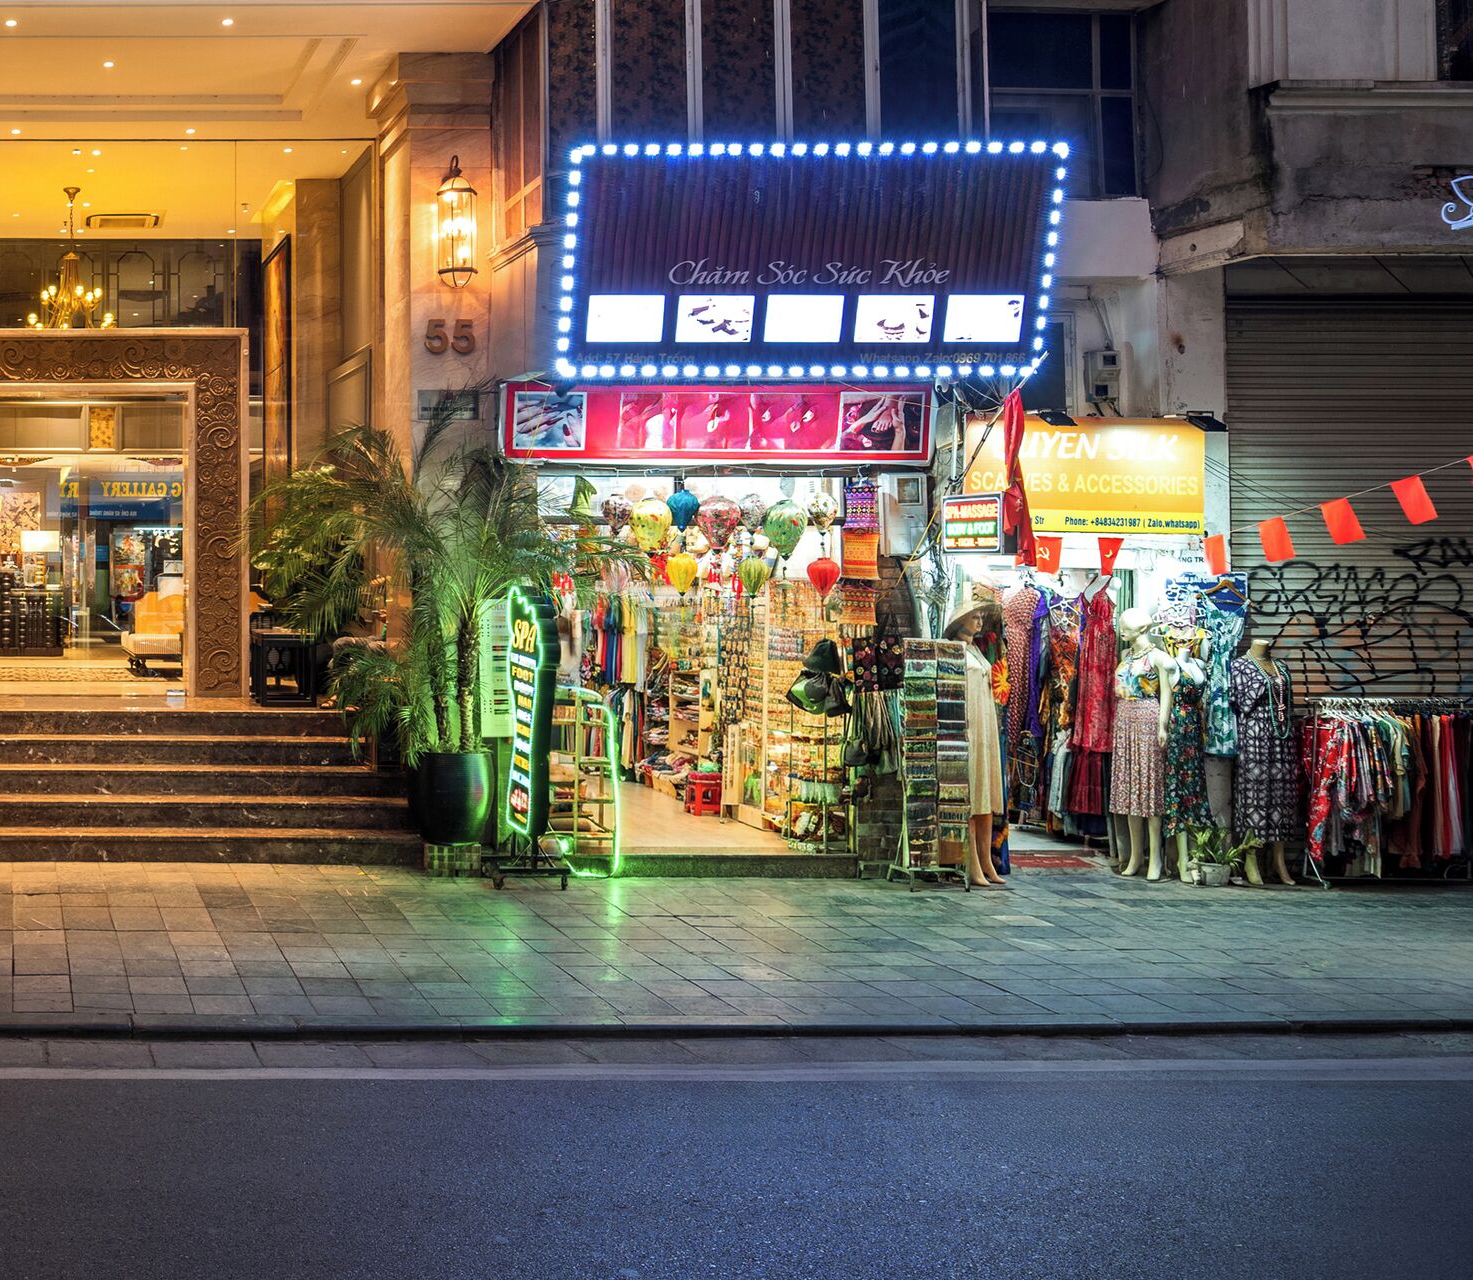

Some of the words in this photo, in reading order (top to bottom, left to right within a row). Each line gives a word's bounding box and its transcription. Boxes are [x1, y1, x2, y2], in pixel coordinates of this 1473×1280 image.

[668, 257, 750, 285] Chăm
[757, 261, 808, 285] Sóc
[813, 261, 872, 285] Sức
[879, 257, 951, 287] Khỏe
[424, 318, 475, 354] 55
[971, 471, 1053, 493] SCAVES
[1058, 473, 1070, 493] &
[1074, 473, 1199, 496] ACCESSORIES
[1065, 516, 1088, 526] Phone:
[512, 619, 536, 653] SPA
[512, 666, 534, 683] FOOT
